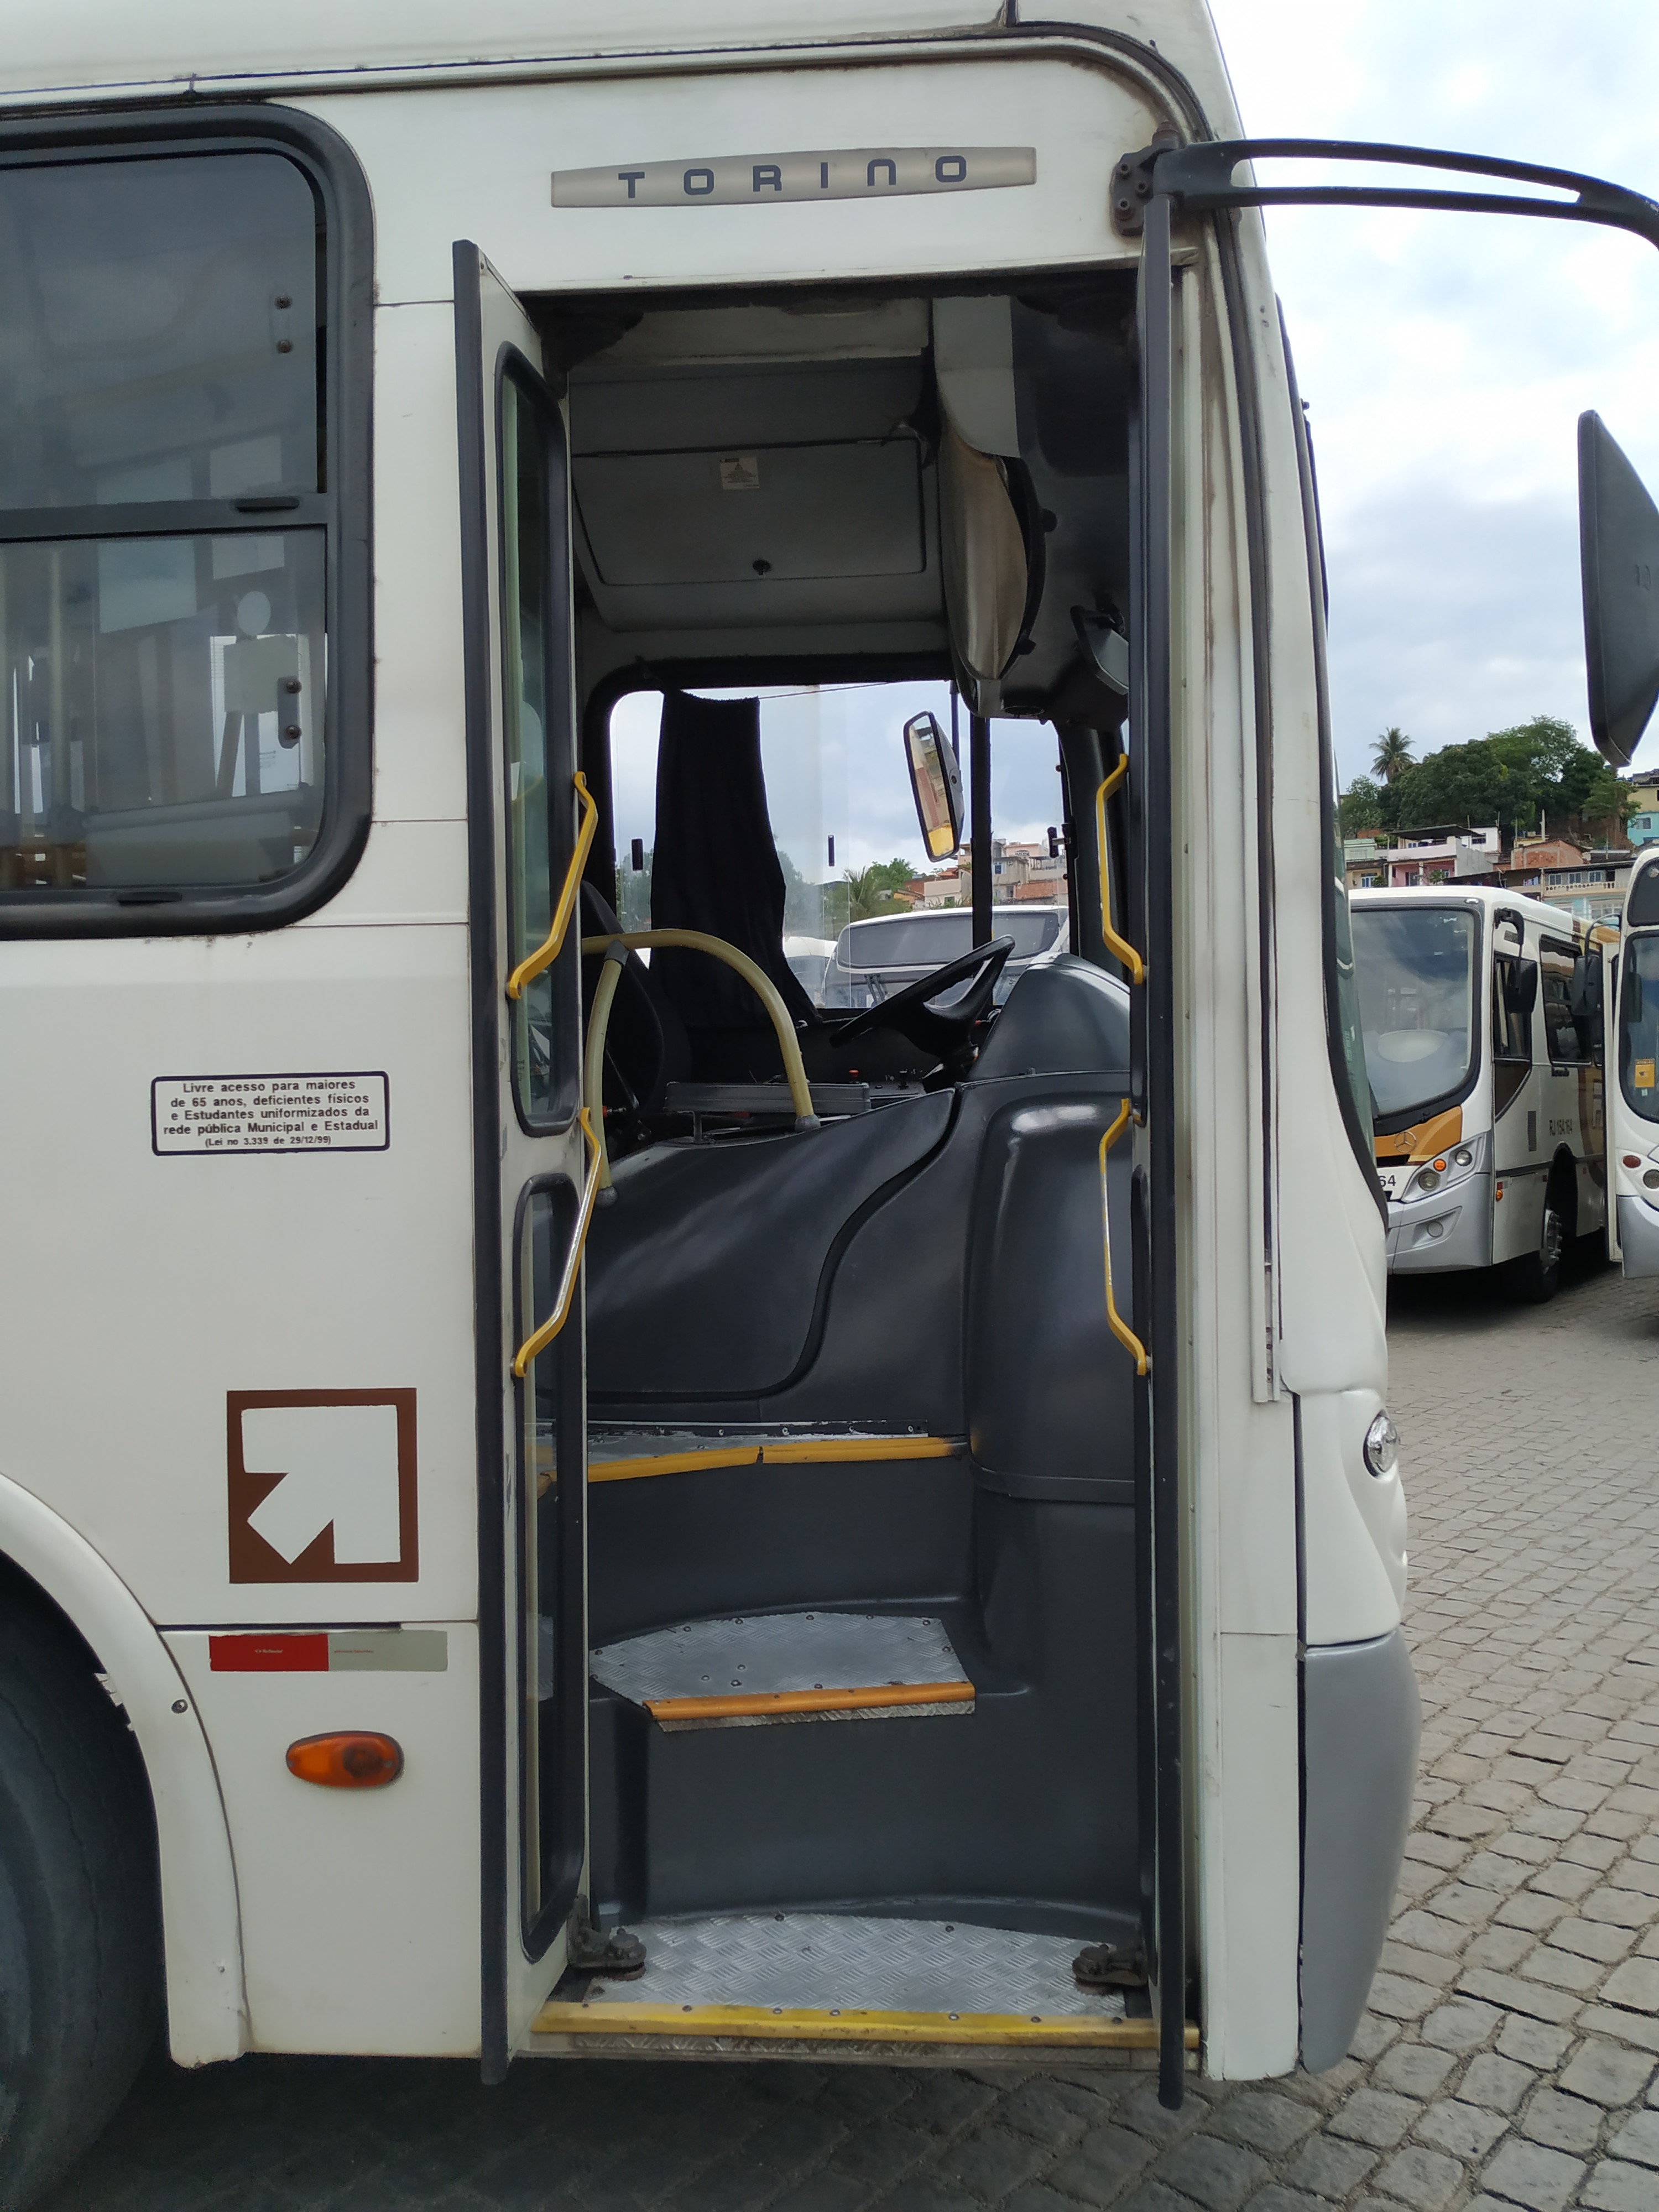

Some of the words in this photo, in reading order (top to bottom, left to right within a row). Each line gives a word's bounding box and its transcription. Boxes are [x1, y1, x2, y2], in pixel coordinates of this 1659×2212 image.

[183, 1083, 215, 1093] Livre
[221, 1083, 265, 1092] acesso
[272, 1082, 300, 1093] para
[306, 1079, 356, 1090] maiores
[170, 1098, 185, 1108] de
[192, 1097, 207, 1107] 65
[213, 1098, 247, 1108] anos,
[253, 1095, 321, 1105] deficientes
[184, 1110, 254, 1120] Estudantes
[260, 1107, 348, 1118] uniformizados
[354, 1107, 370, 1117] da
[164, 1124, 191, 1134] rede
[197, 1123, 241, 1136] pública
[248, 1121, 305, 1134] Municipal
[325, 1120, 378, 1131] Estadual
[205, 1138, 223, 1147] (Lei
[290, 1136, 331, 1145] 29/12/99)
